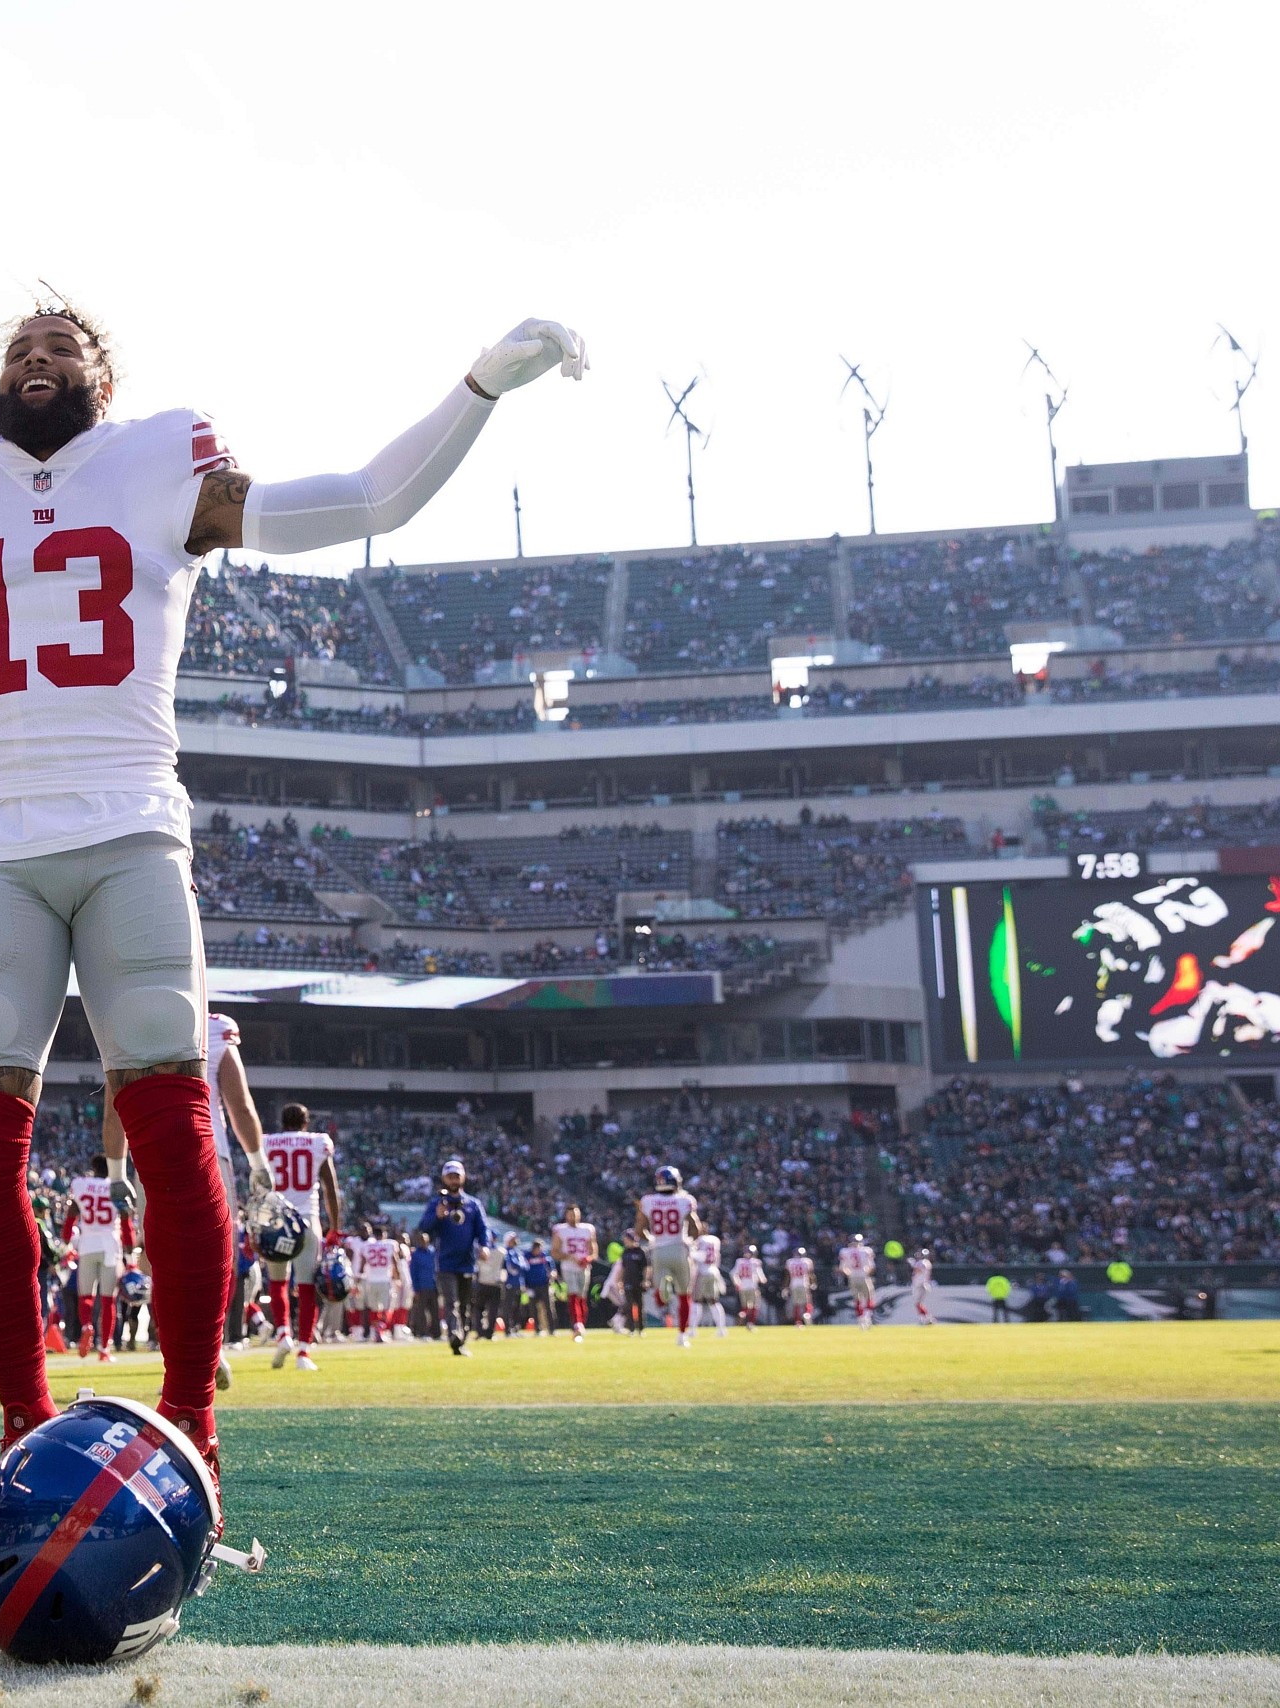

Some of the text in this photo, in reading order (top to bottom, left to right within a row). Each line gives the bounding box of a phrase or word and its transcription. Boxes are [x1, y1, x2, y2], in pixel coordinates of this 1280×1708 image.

[35, 479, 49, 490] NFL
[1077, 852, 1140, 879] 7:58
[268, 1149, 313, 1191] 30
[80, 1194, 113, 1225] 35
[651, 1209, 680, 1235] 88
[93, 1444, 113, 1460] NFL
